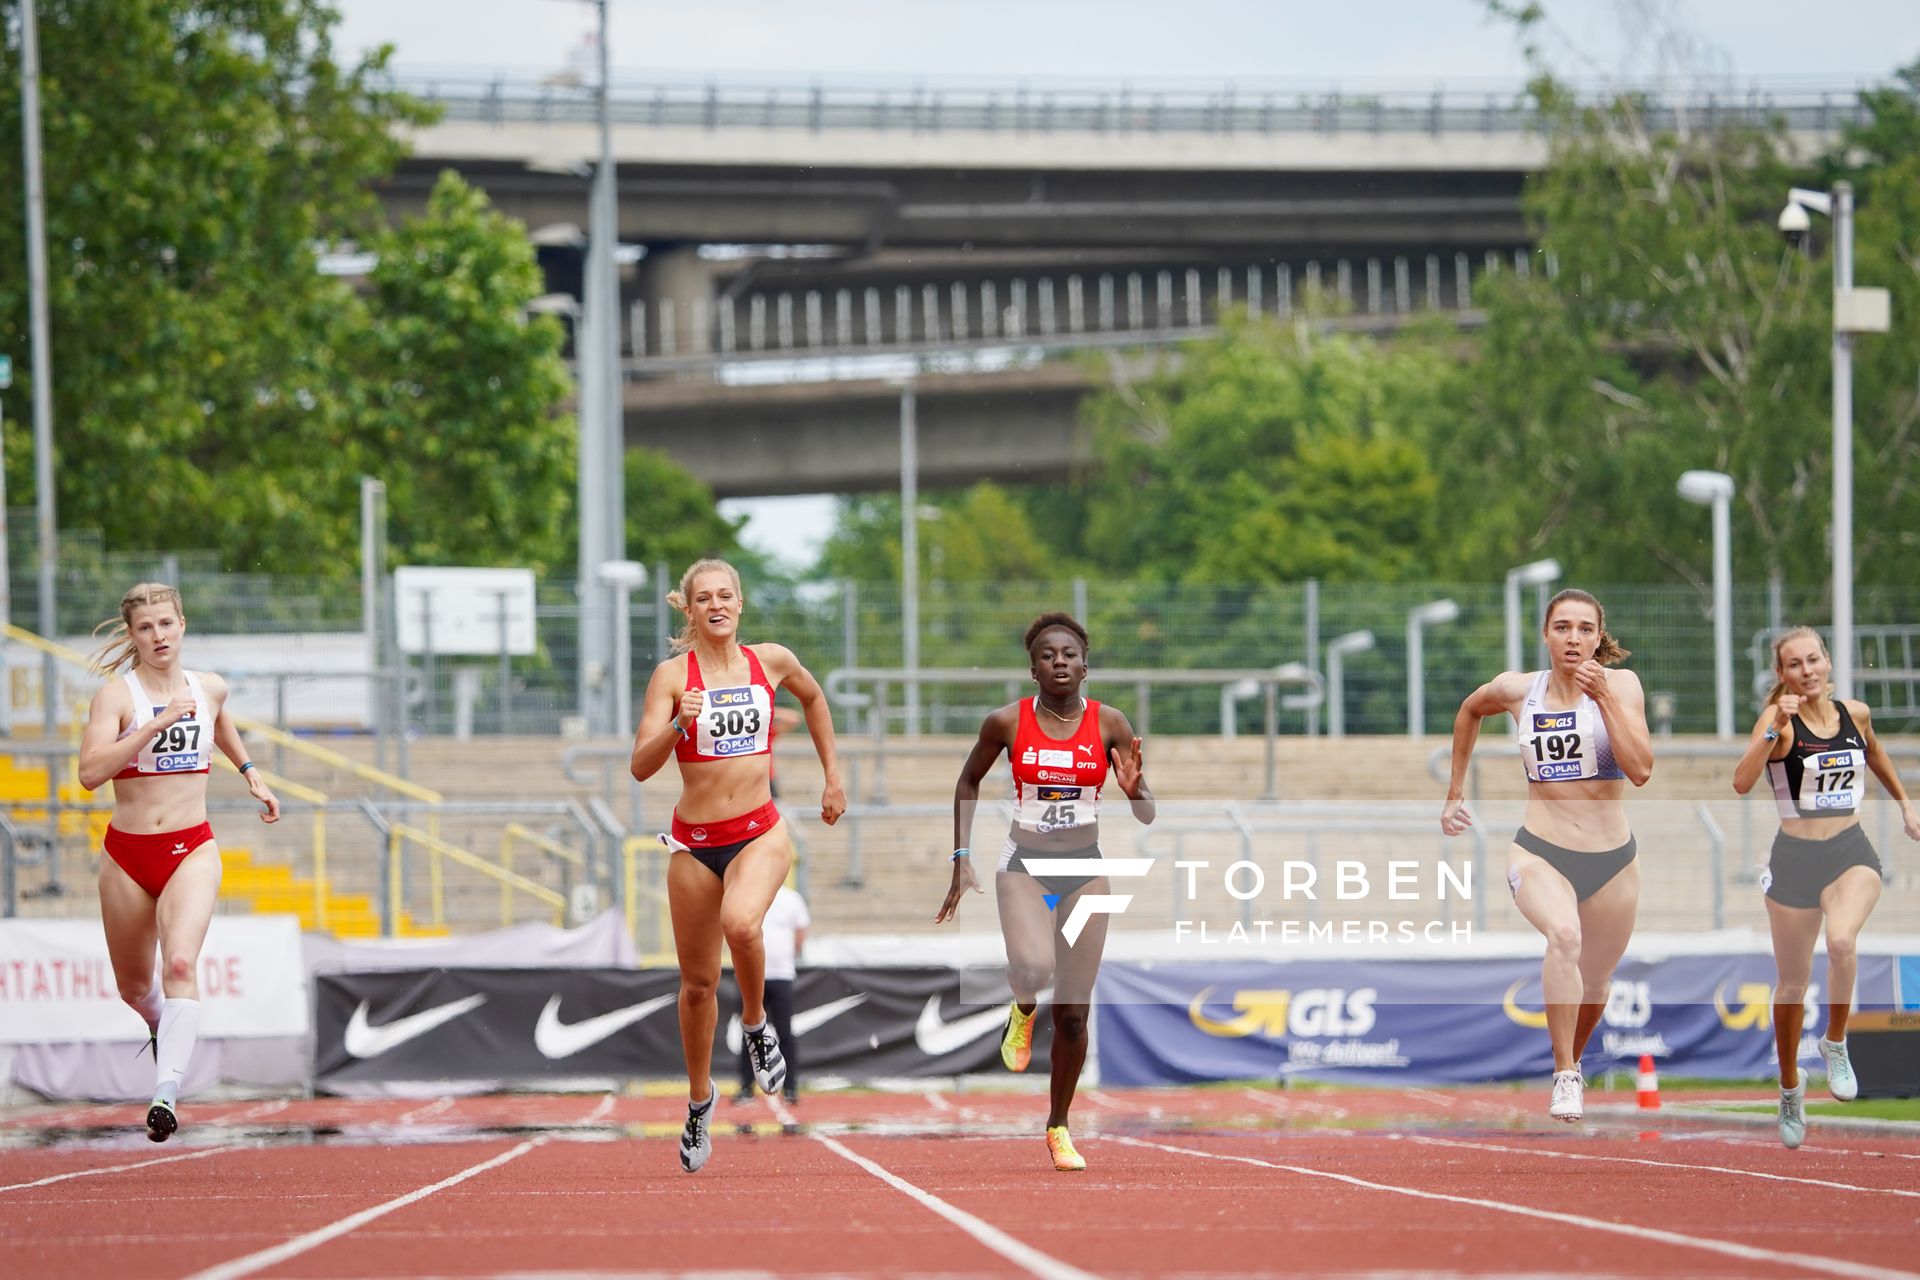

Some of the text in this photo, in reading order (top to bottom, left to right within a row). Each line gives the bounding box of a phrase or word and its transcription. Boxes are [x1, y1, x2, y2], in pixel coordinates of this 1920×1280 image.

[732, 692, 749, 703] GLS
[709, 708, 760, 737] 303
[1556, 717, 1573, 728] GLS
[152, 725, 200, 753] 297
[731, 738, 754, 748] PLAN
[1530, 733, 1582, 761] 192
[1555, 764, 1580, 773] PLAN
[1836, 755, 1850, 766] GLS
[1815, 770, 1855, 793] 172
[1041, 804, 1076, 826] 45
[1288, 988, 1377, 1037] GLS
